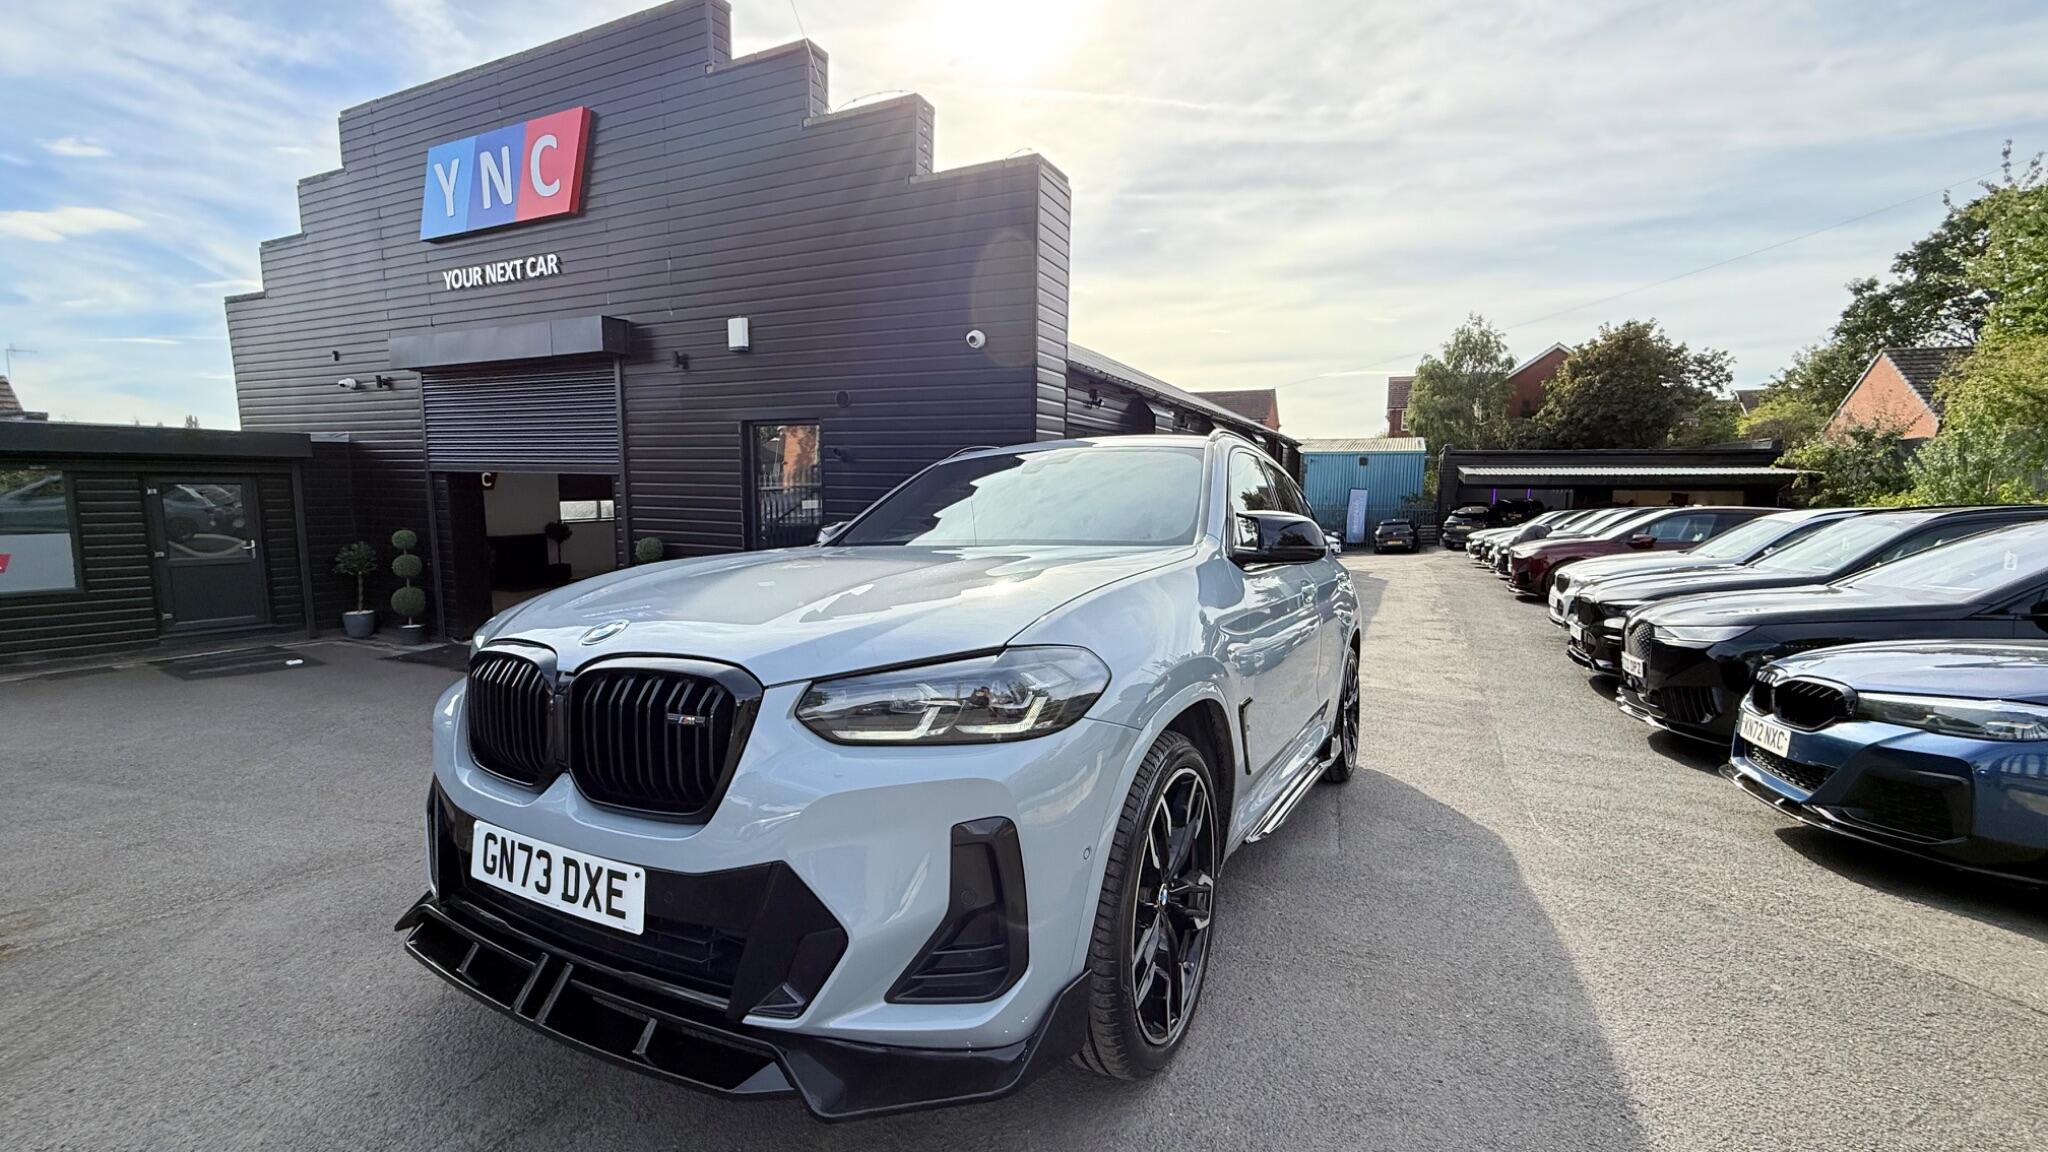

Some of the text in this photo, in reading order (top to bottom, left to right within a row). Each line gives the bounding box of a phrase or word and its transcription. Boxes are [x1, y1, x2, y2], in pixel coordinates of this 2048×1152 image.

[433, 134, 561, 217] YNC
[442, 253, 559, 290] YOUR NEXT CAR
[1764, 725, 1785, 750] NXC
[483, 832, 628, 920] GN73 DXE
